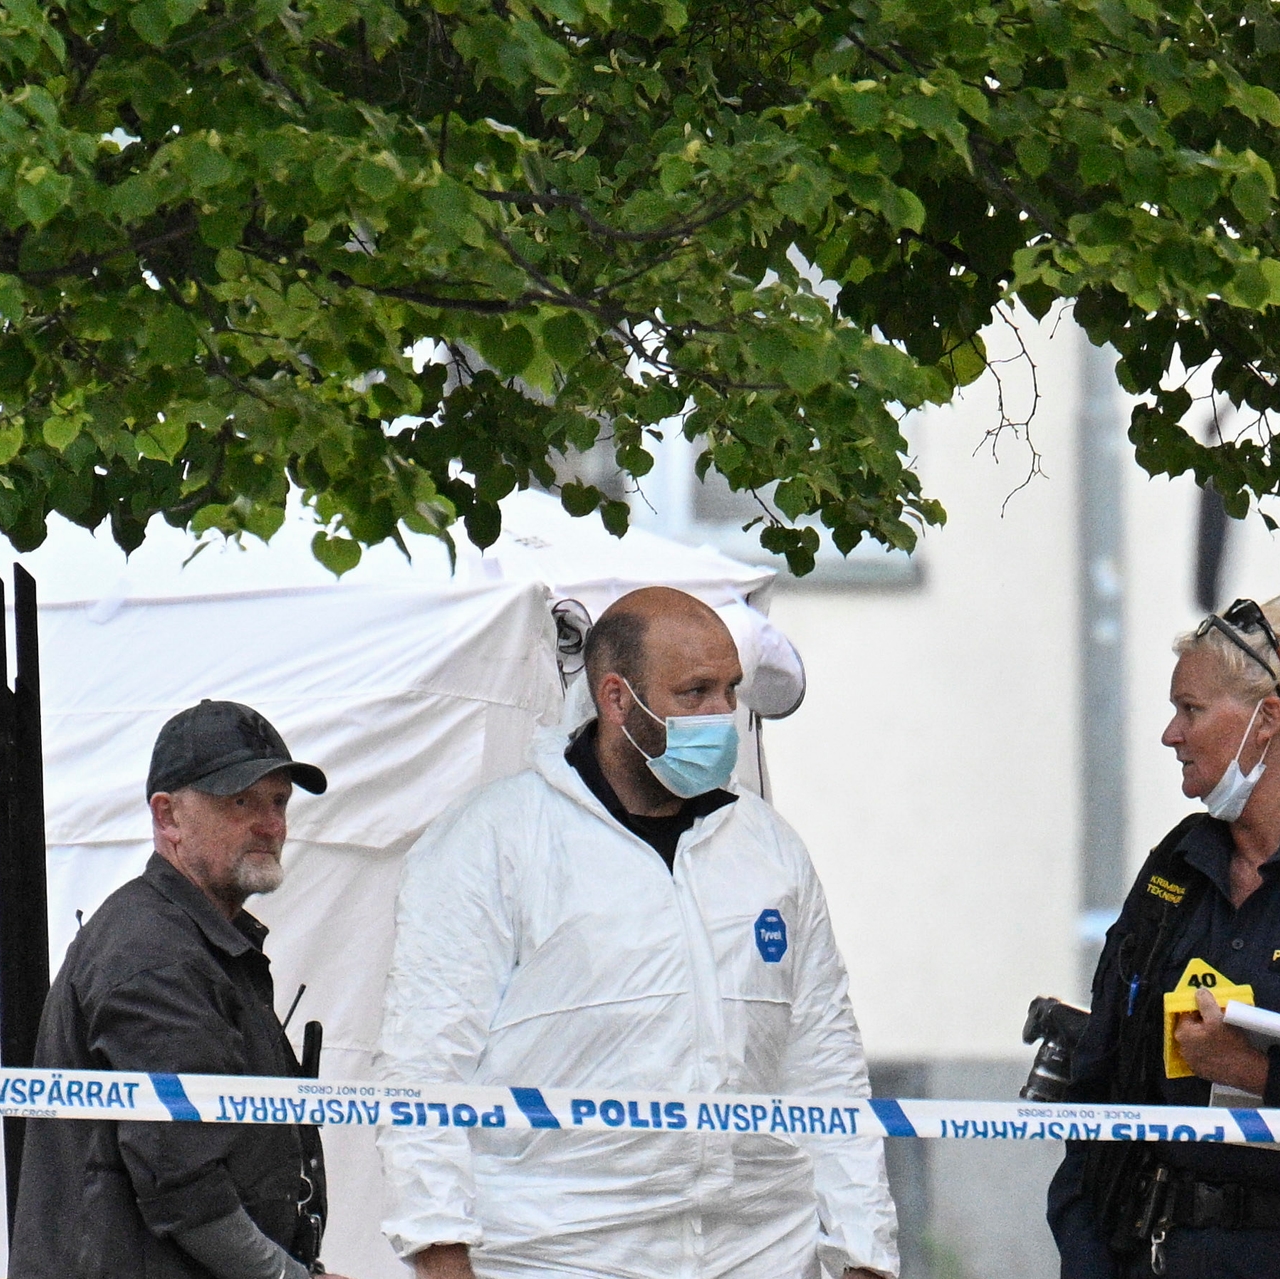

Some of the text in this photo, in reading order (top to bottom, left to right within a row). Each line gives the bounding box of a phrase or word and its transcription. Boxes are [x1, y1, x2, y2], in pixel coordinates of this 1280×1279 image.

[1187, 973, 1217, 989] 40
[297, 1085, 333, 1094] CROSS
[335, 1086, 358, 1095] NOT
[359, 1087, 375, 1096] DO
[384, 1088, 422, 1098] POLICE
[390, 1101, 507, 1128] POLIS
[570, 1099, 860, 1135] POLIS AVSPÄRRAT
[1017, 1108, 1053, 1117] CROSS
[1055, 1109, 1078, 1118] NOT
[1079, 1110, 1095, 1119] DO
[1104, 1110, 1141, 1119] POLICE
